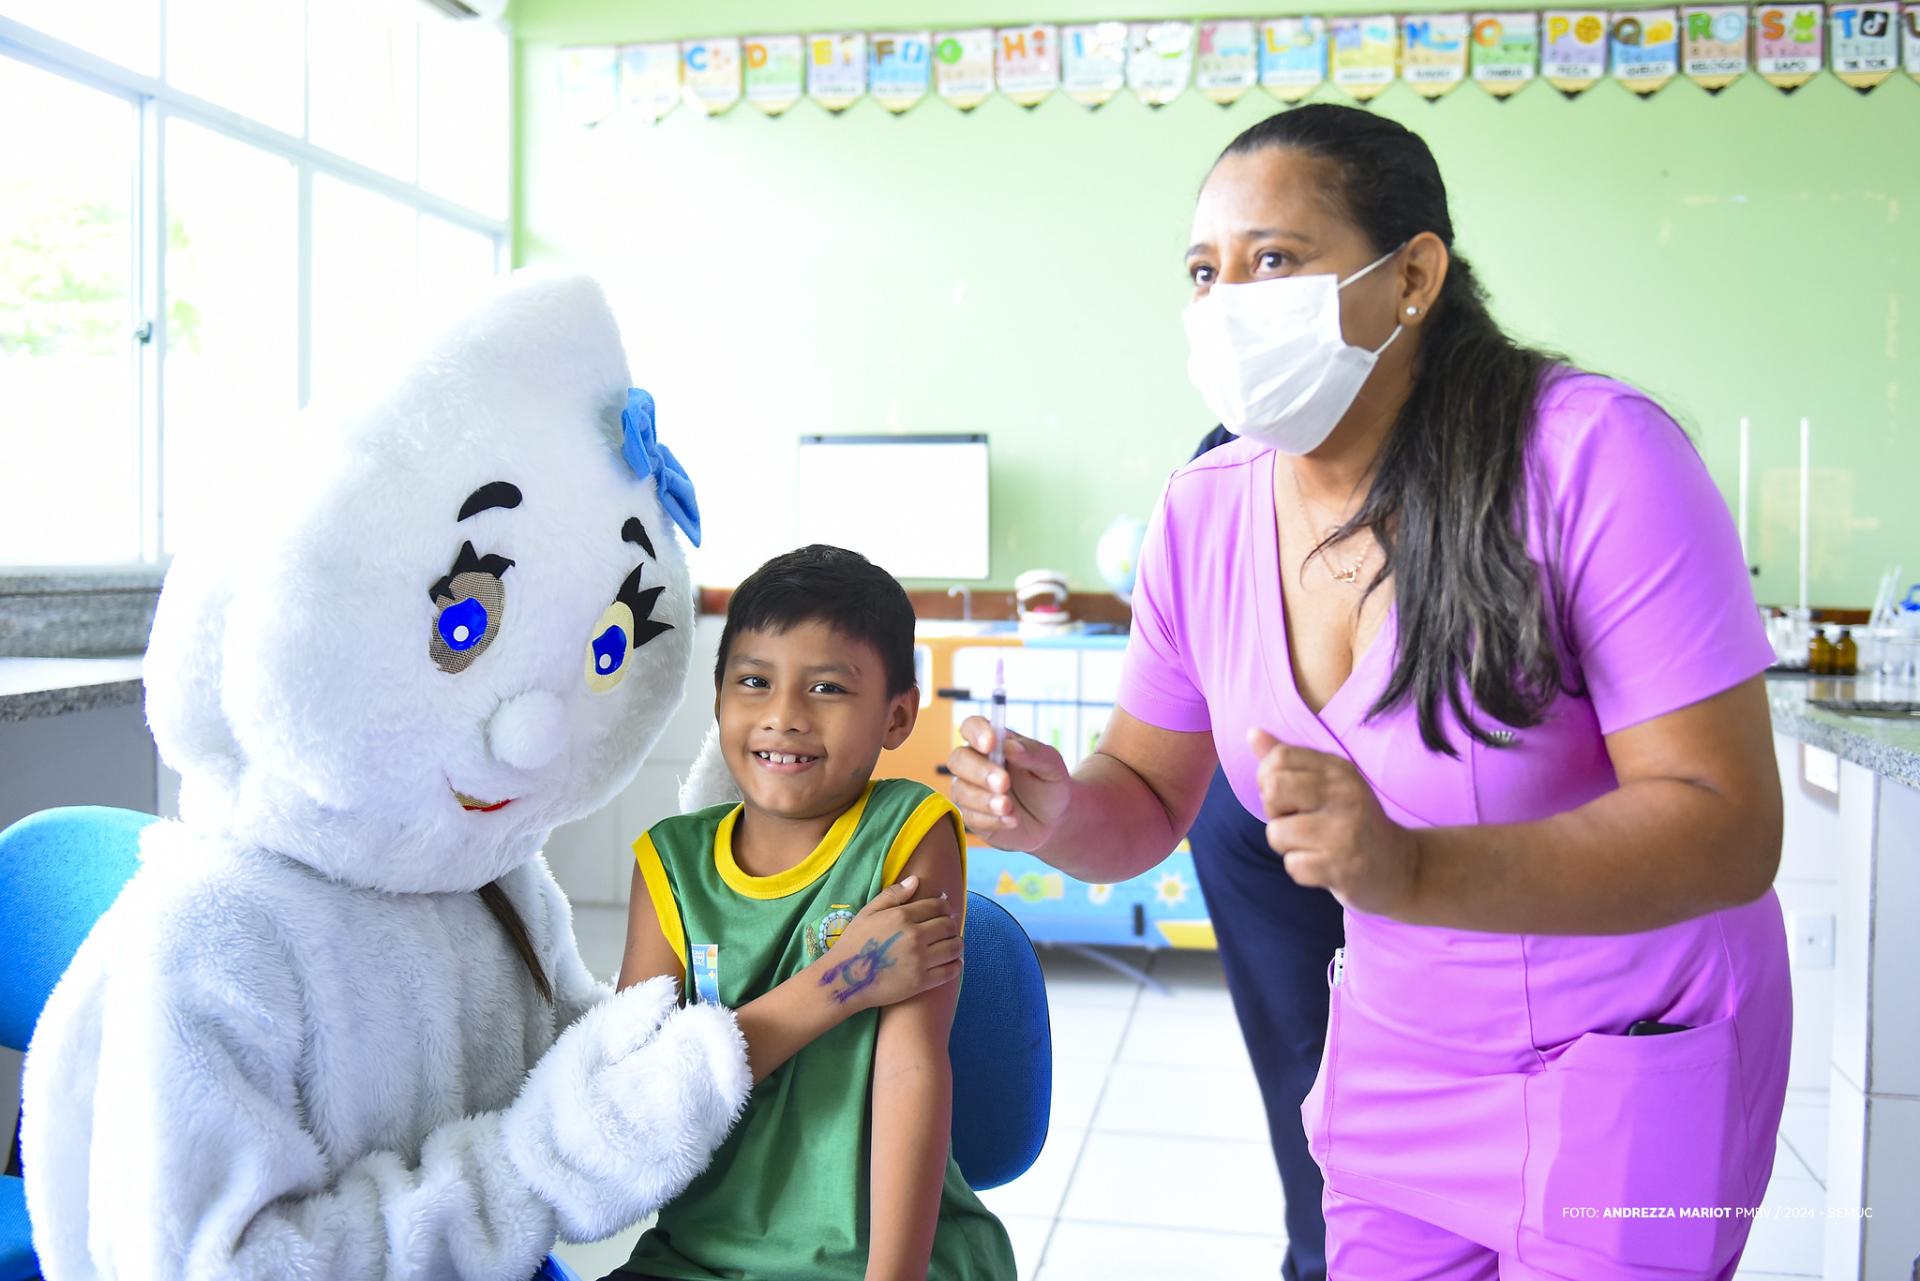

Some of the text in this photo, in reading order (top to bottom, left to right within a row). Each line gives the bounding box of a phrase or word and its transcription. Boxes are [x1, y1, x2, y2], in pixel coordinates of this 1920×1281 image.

[1548, 16, 1569, 45] P
[1688, 11, 1712, 41] R
[1761, 9, 1785, 40] S
[1834, 9, 1857, 39] T
[812, 39, 833, 65] E
[874, 39, 895, 65] F
[1003, 33, 1026, 61] H
[1266, 27, 1290, 53] L
[686, 45, 708, 71] C
[747, 43, 768, 68] D
